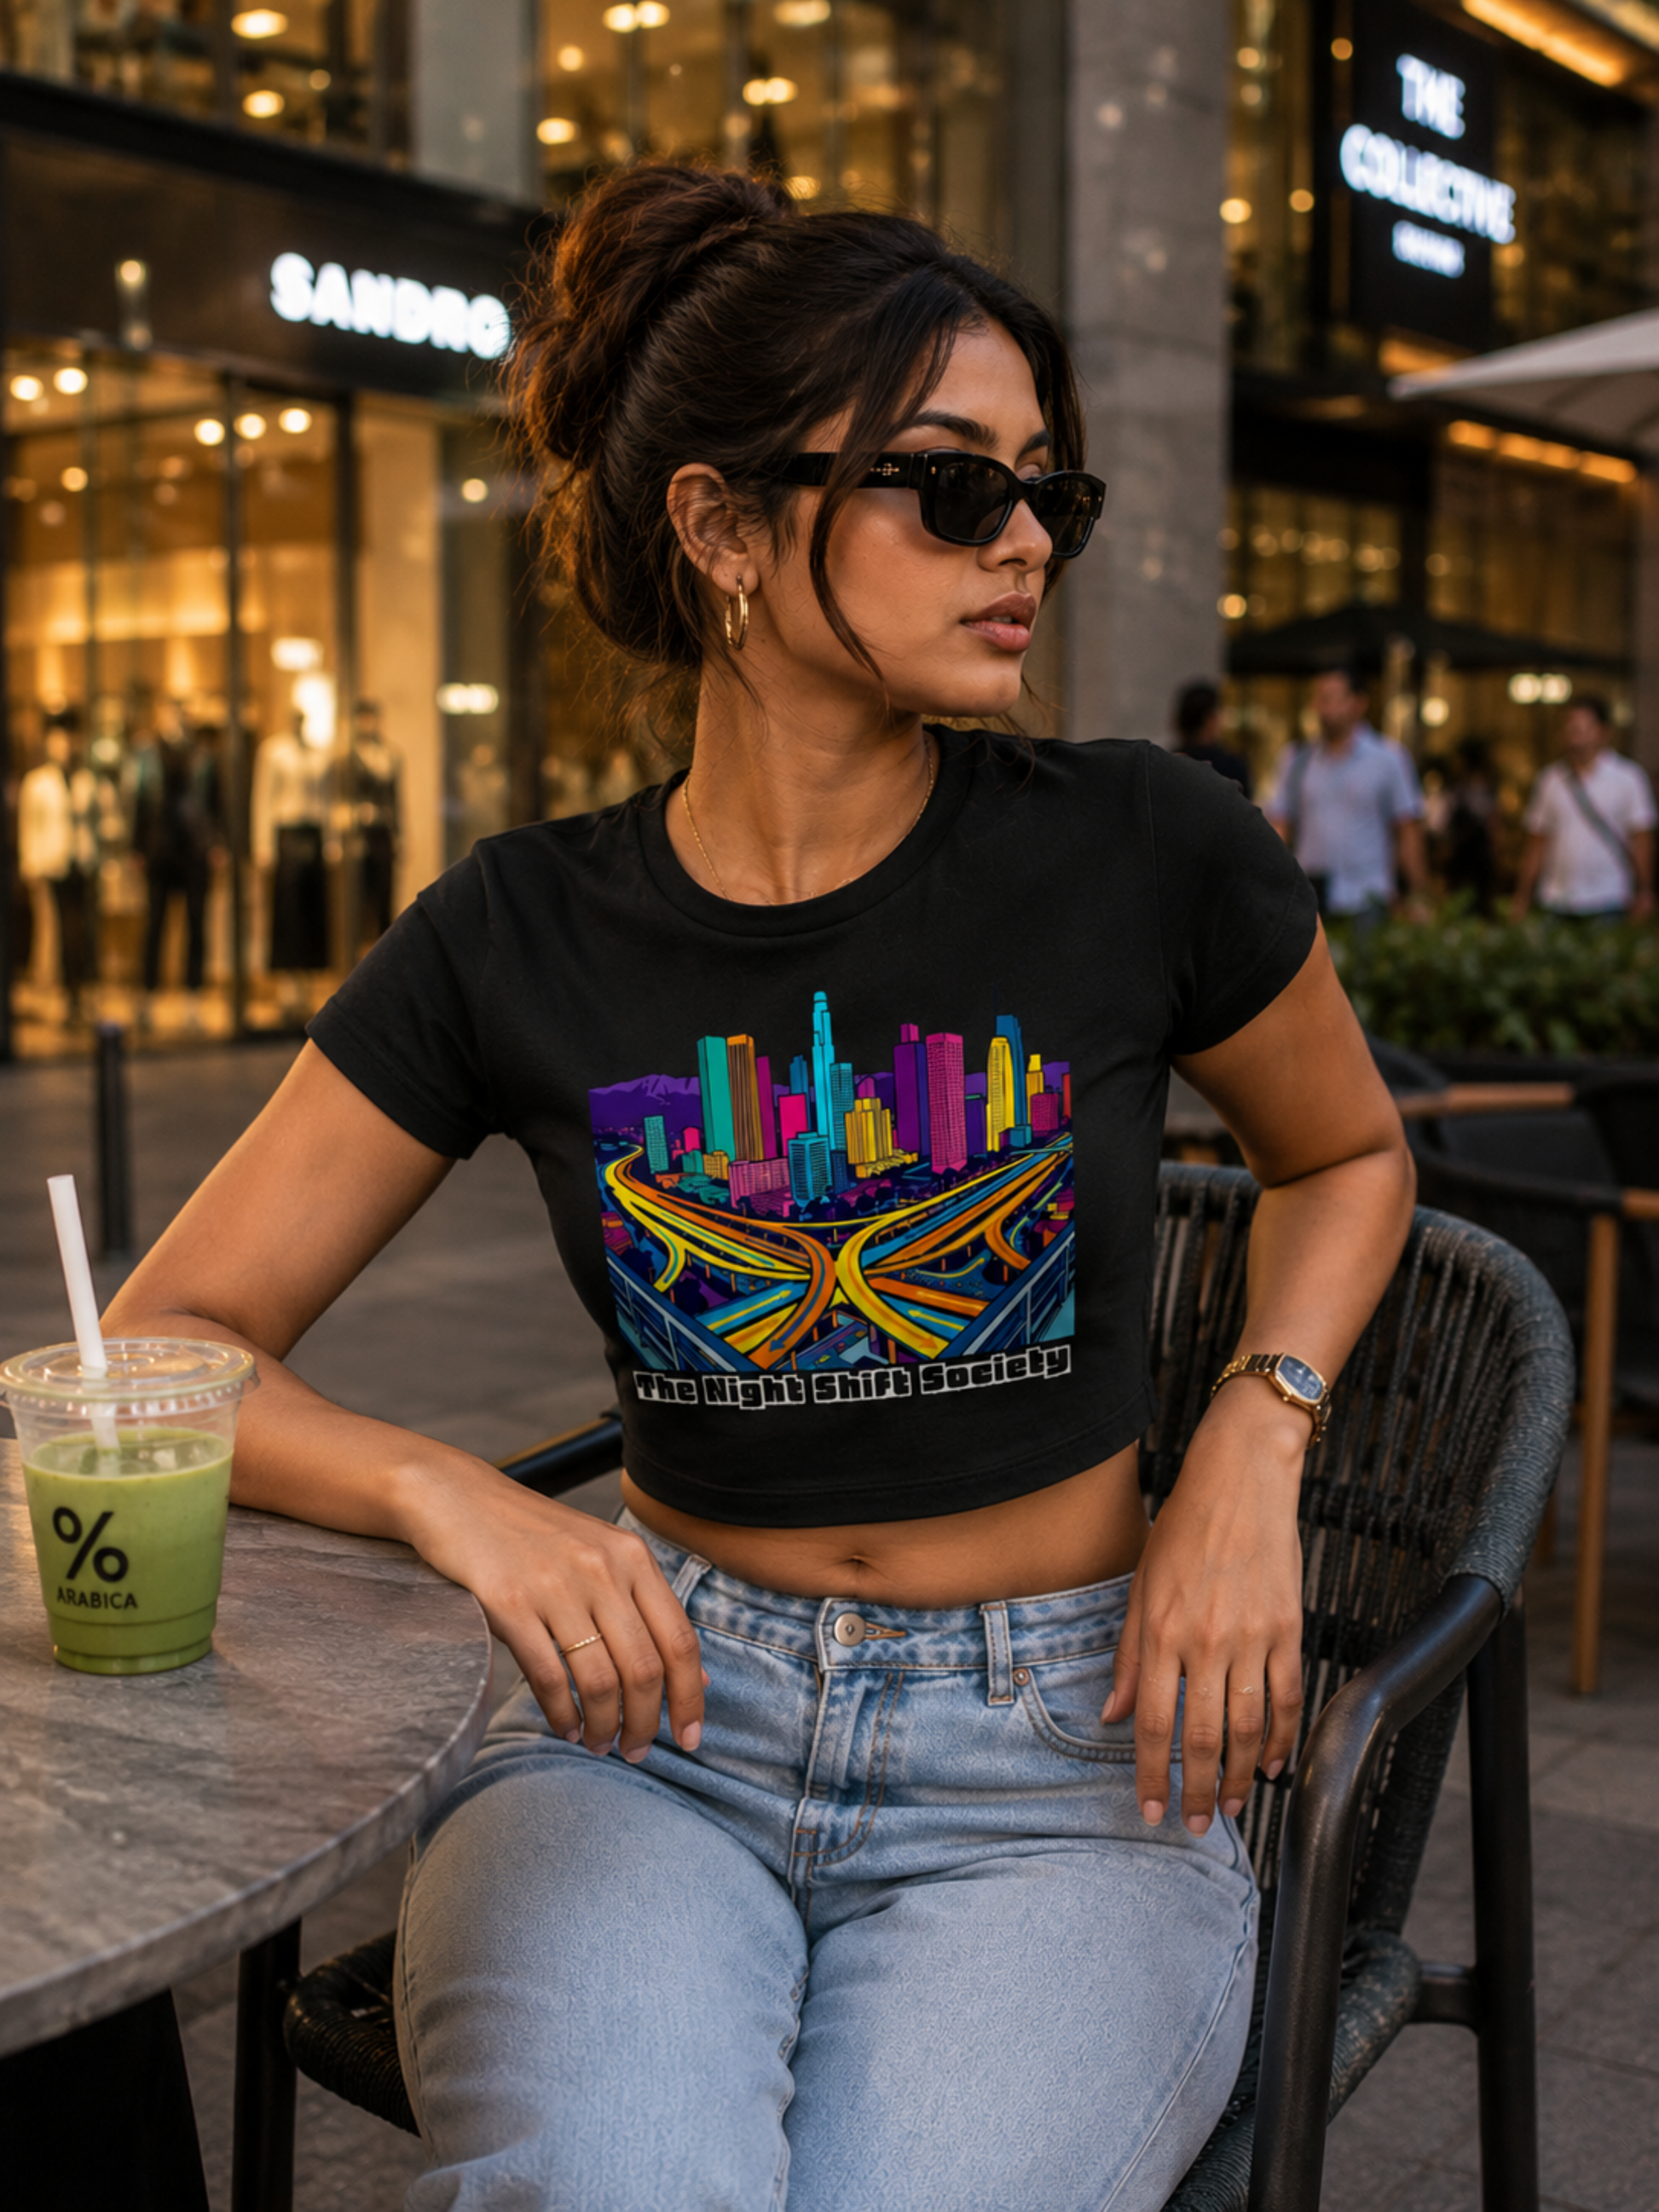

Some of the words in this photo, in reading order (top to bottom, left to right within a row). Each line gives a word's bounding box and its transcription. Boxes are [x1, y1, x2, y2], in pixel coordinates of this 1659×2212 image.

[1396, 54, 1465, 140] THE
[1340, 124, 1516, 245] COLLECTIVE
[270, 252, 511, 360] SANDRO
[633, 1371, 698, 1404] The
[702, 1373, 806, 1410] Night
[812, 1366, 911, 1404] Shift
[919, 1344, 1071, 1395] Society
[57, 1586, 138, 1609] ARABICA
